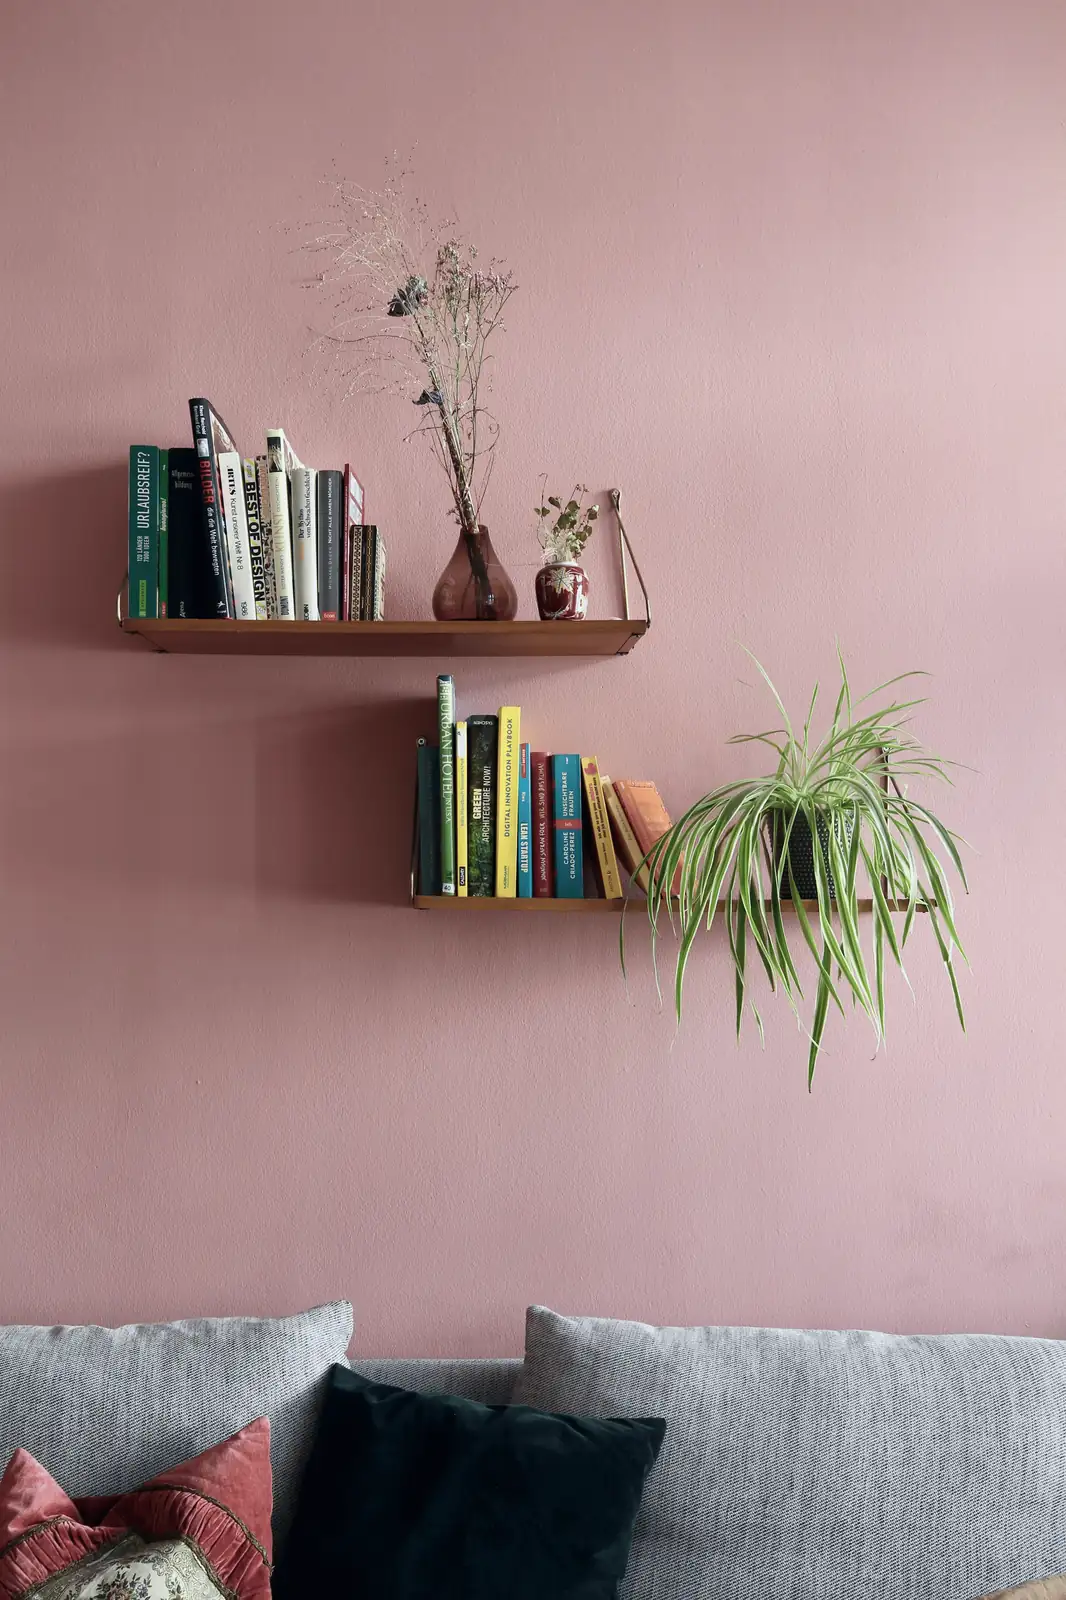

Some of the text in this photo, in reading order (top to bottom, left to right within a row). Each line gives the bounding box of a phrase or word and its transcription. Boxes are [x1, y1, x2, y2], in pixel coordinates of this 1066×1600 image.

[137, 452, 150, 528] URLAUBSREIF?
[246, 482, 258, 520] BEST
[200, 460, 214, 504] BILDER
[211, 544, 220, 576] bewegten
[249, 522, 261, 541] OF
[274, 512, 284, 552] KUNST
[251, 546, 266, 602] DESIGN
[240, 602, 248, 616] 1986
[280, 596, 290, 616] DUMONT
[440, 704, 452, 750] URBAN
[442, 754, 453, 798] HOTEL
[473, 788, 482, 820] GREEN
[482, 766, 492, 843] ARCHITECTURE NOW!
[520, 823, 528, 873] LEAN STARTUP
